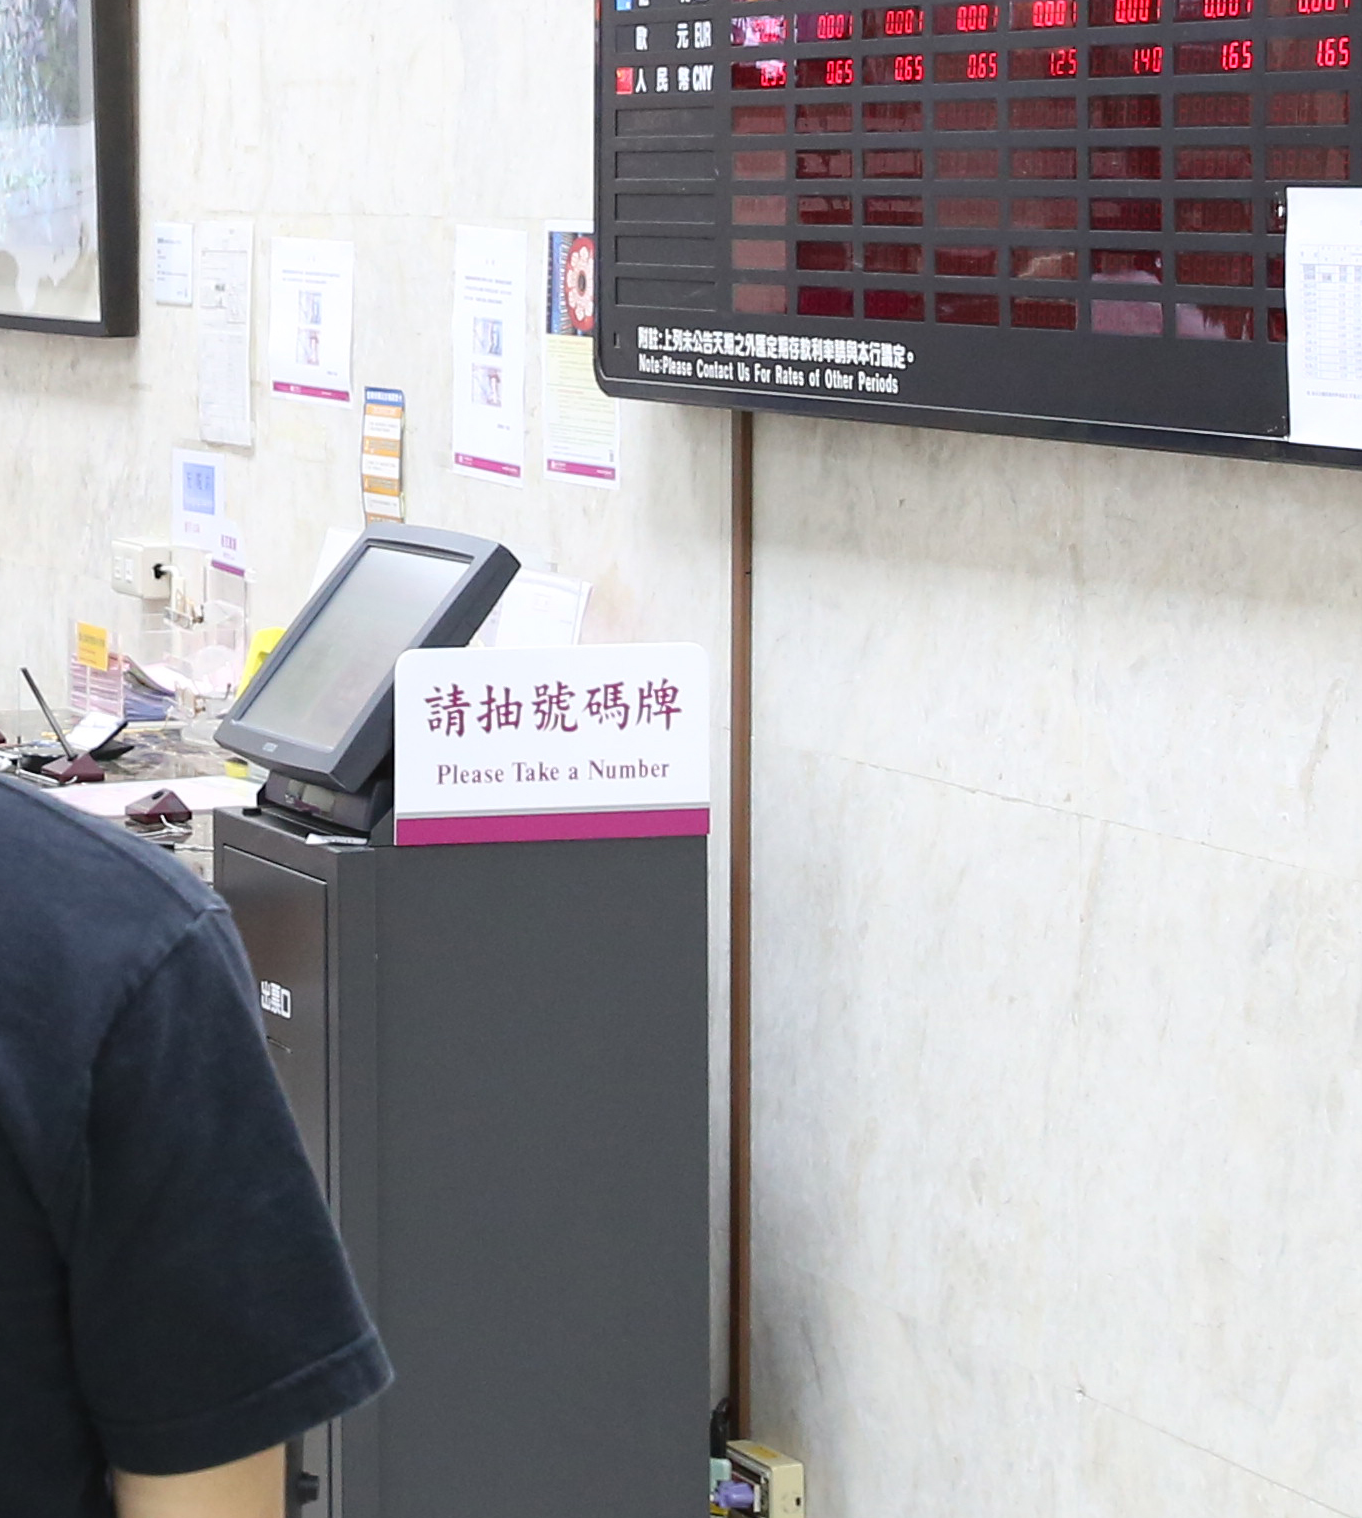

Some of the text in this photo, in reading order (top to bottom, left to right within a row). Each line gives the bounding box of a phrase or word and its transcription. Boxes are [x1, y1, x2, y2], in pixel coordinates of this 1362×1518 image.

[696, 358, 734, 381] Contact
[737, 361, 751, 382] Us
[754, 363, 772, 384] For
[775, 364, 805, 387] Rates
[809, 368, 821, 388] of
[824, 369, 854, 391] Other
[858, 370, 900, 395] Periods
[423, 677, 683, 738] 請抽號碼牌
[436, 757, 670, 785] Please Take a Number
